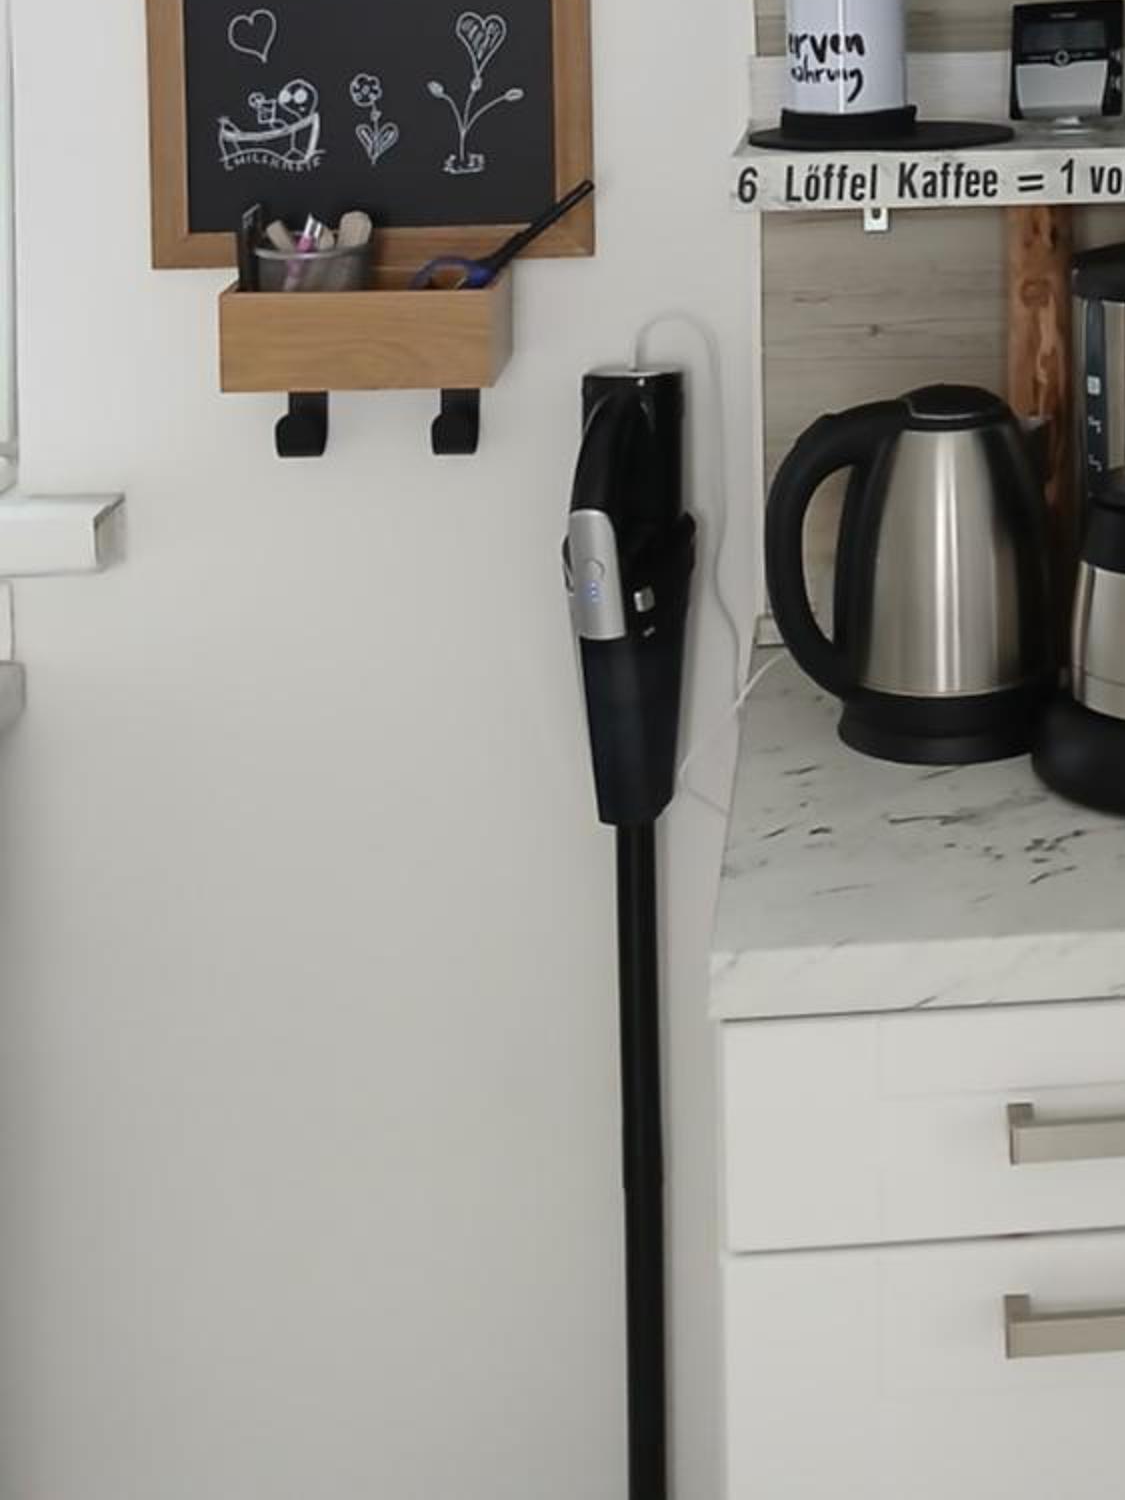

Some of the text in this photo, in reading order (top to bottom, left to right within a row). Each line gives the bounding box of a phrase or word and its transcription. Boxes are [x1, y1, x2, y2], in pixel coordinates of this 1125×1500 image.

[737, 166, 758, 204] 6
[785, 163, 877, 202] Löffel
[898, 161, 998, 199] Kaffee
[1017, 173, 1045, 193] =
[1060, 157, 1075, 194] 1
